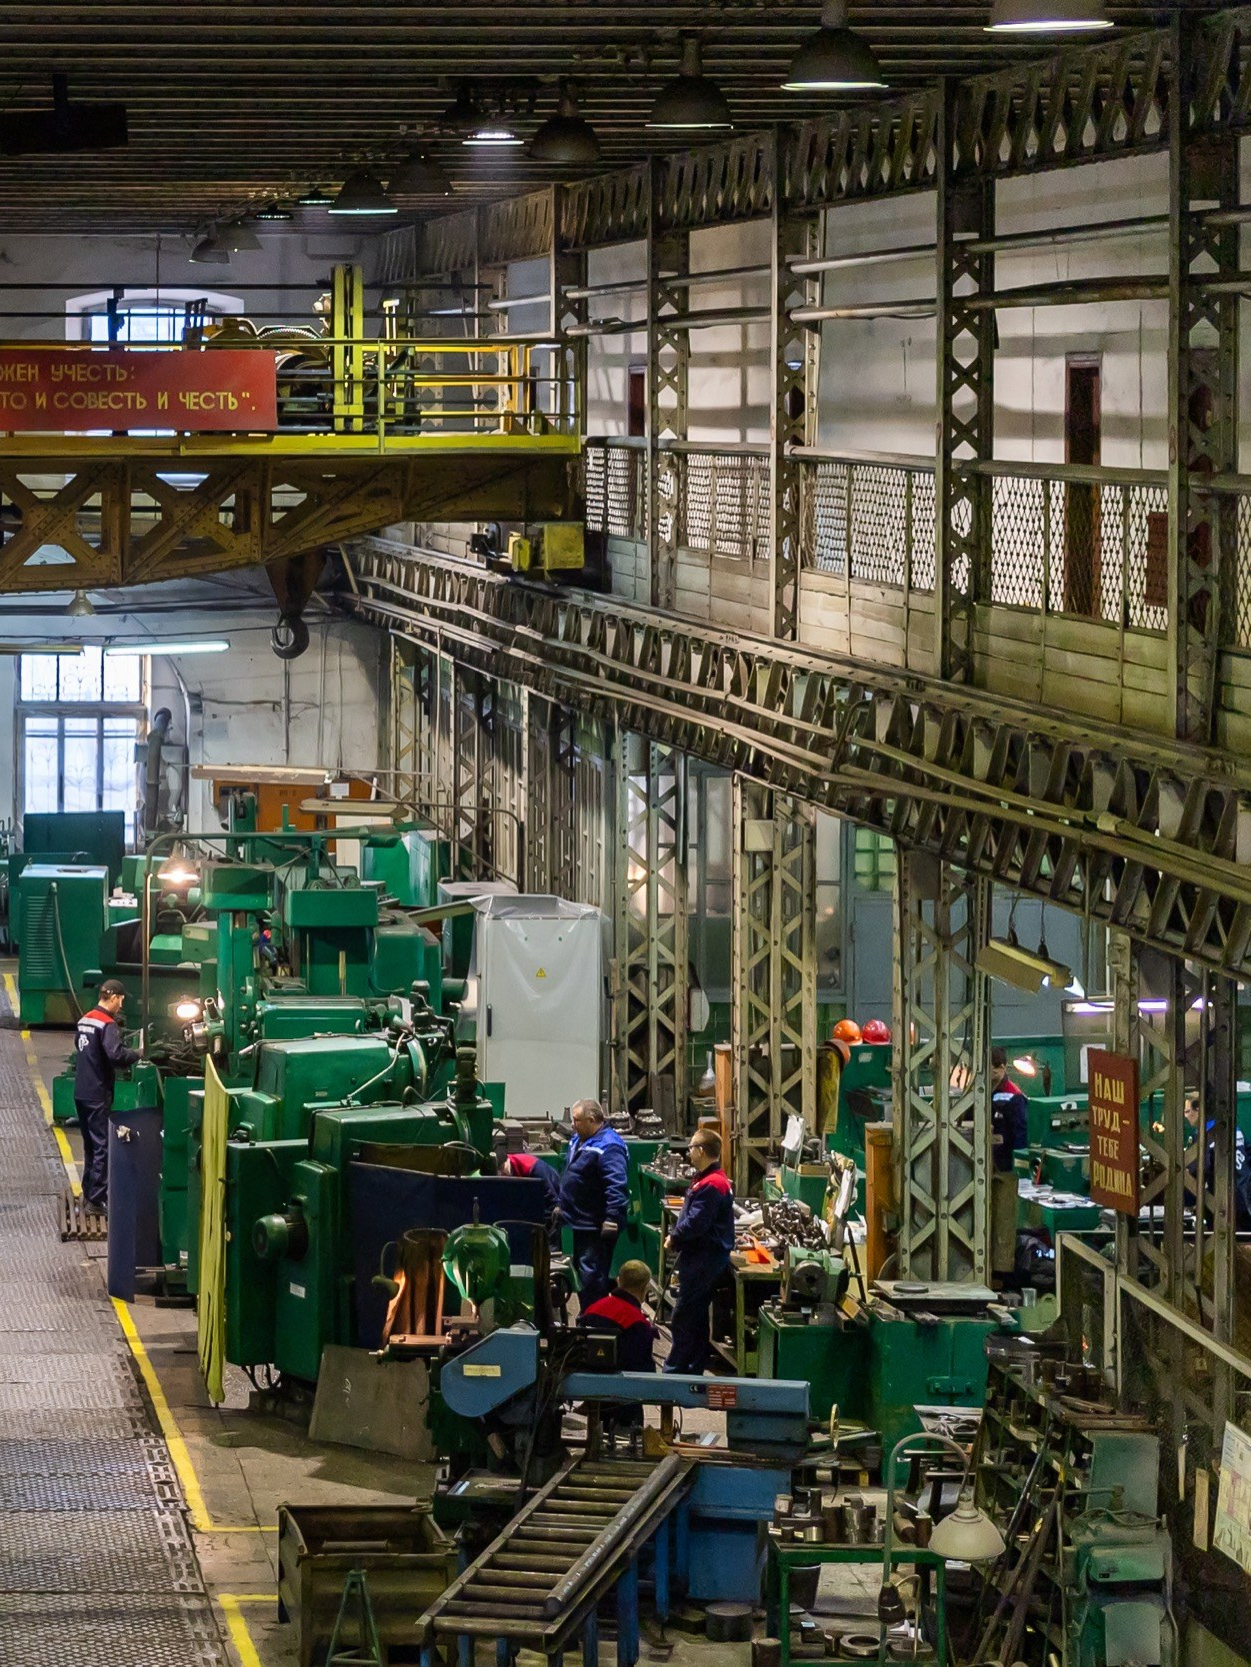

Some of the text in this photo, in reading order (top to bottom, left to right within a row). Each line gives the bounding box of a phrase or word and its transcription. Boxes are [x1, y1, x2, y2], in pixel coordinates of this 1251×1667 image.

[51, 363, 136, 383] УЧЕСТЬ:
[35, 391, 47, 410] И
[53, 391, 148, 410] СОВЕСТЬ
[157, 391, 169, 410] И
[1094, 1072, 1125, 1104] НАШ
[1096, 1135, 1120, 1161] ТЕБЕ
[1092, 1160, 1133, 1198] РОДИНА
